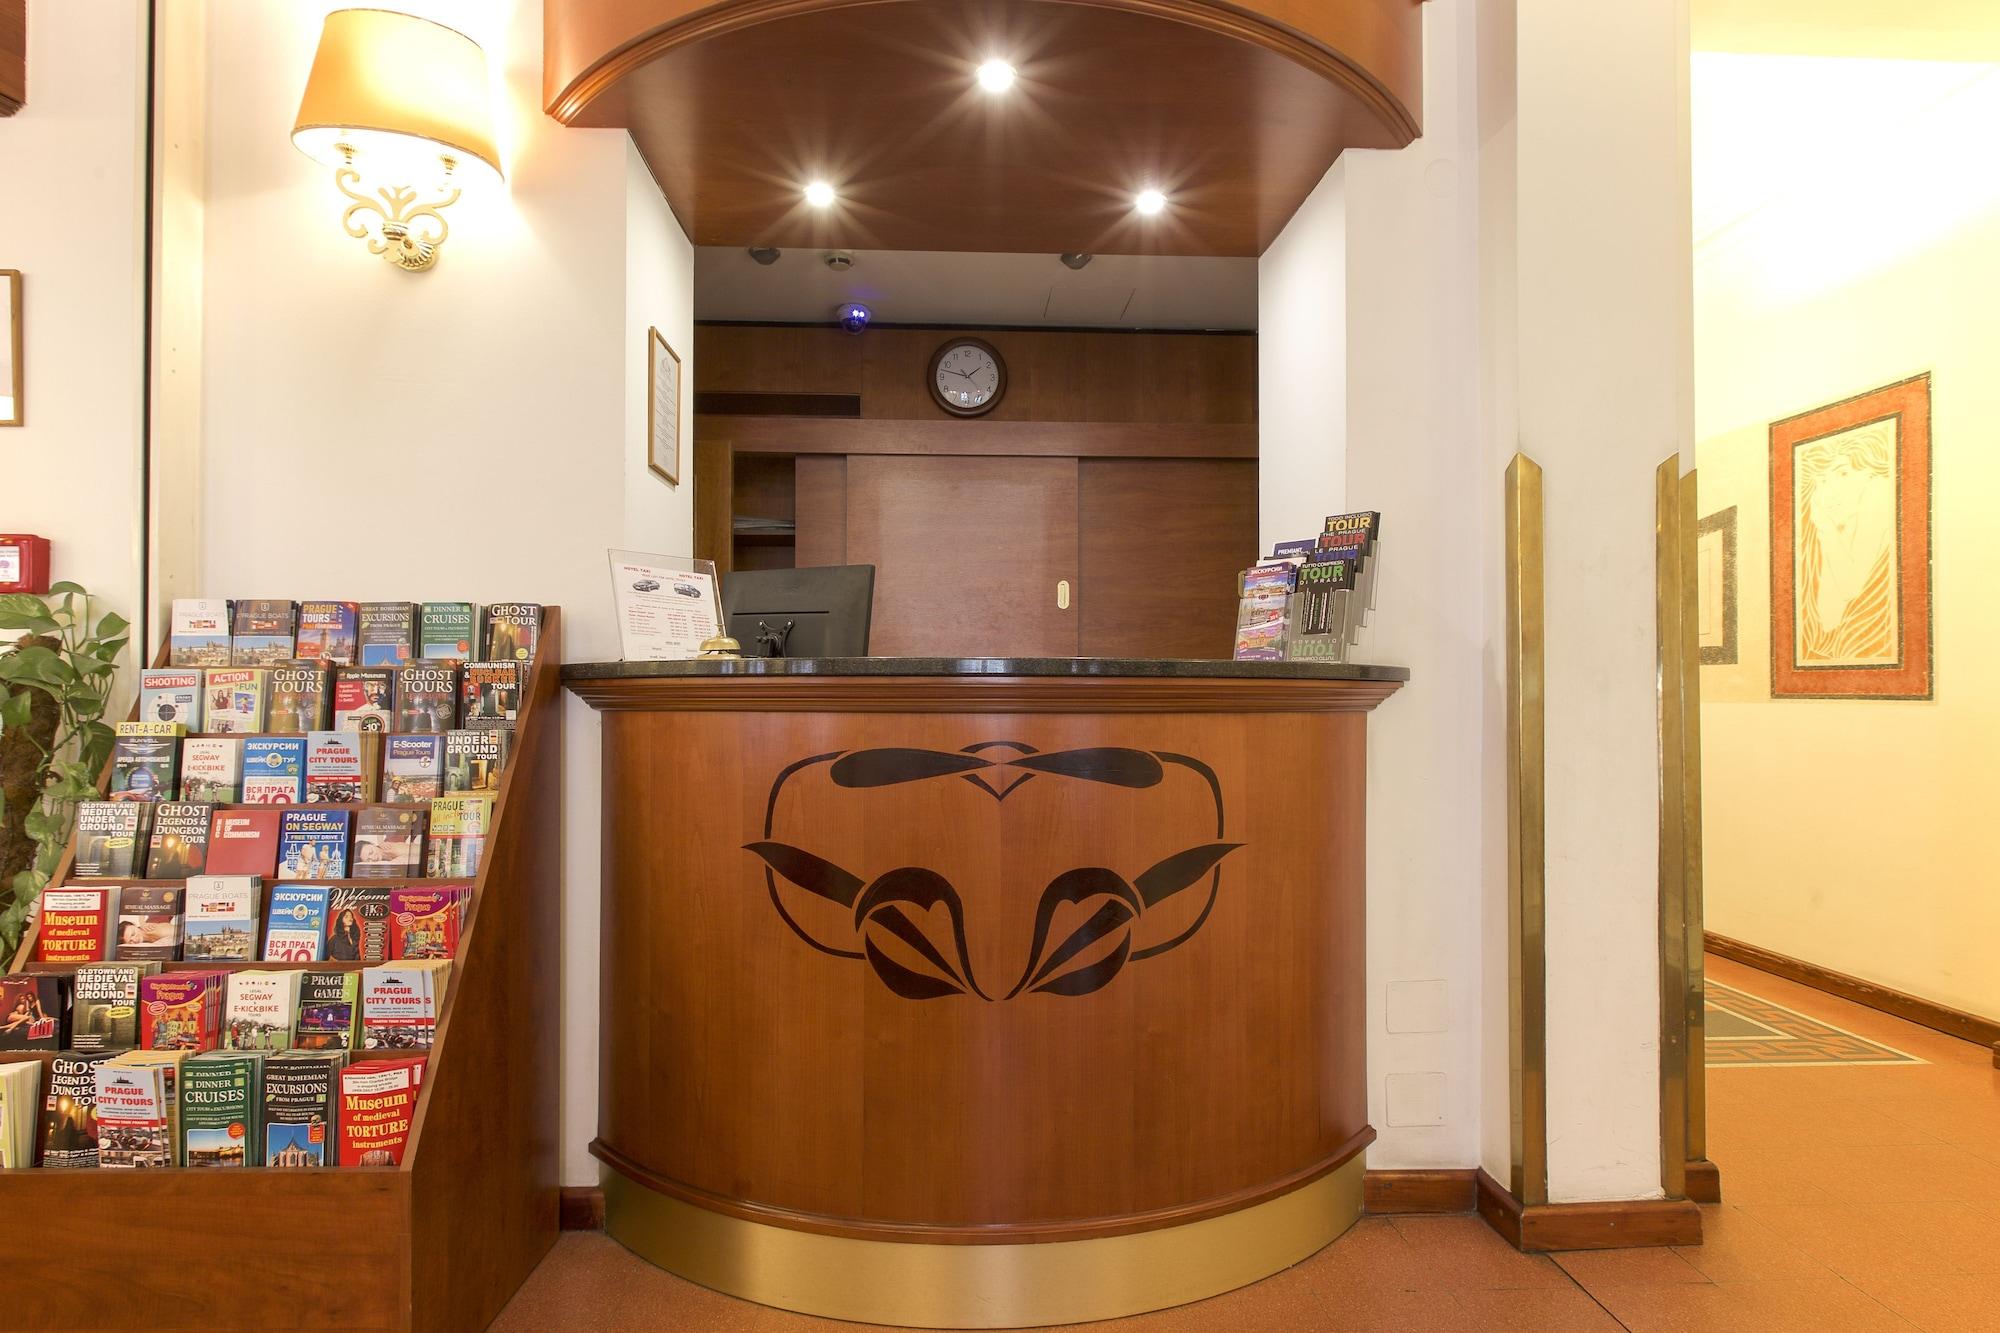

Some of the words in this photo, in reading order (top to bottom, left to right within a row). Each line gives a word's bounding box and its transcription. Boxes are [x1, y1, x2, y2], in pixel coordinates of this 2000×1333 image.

[1328, 518, 1370, 531] TOUR
[1322, 533, 1366, 548] TOUR
[1302, 566, 1344, 580] TOUR
[303, 604, 337, 614] PRAGUE
[492, 605, 536, 616] GHOST
[302, 614, 330, 622] TOURS
[362, 613, 410, 622] EXCURSIONS
[424, 614, 470, 624] CRUISES
[505, 616, 536, 626] TOUR
[214, 672, 249, 682] ACTION
[274, 669, 324, 680] GHOST
[404, 669, 453, 680] GHOST
[146, 677, 195, 686] SHOOTING
[272, 681, 324, 692] TOURS
[402, 681, 452, 692] TOURS
[120, 724, 172, 734] RENT-A-CAR
[448, 736, 489, 744] UNDER
[447, 745, 498, 754] GROUND
[157, 804, 209, 816] GHOST
[433, 801, 464, 810] PRAGUE
[157, 817, 198, 826] LEGENDS
[200, 816, 208, 826] &
[286, 814, 327, 822] PRAGUE
[458, 812, 481, 821] TOUR
[156, 826, 206, 835] DUNGEON
[286, 822, 300, 830] ON
[302, 822, 344, 830] SEGWAY
[180, 834, 206, 844] TOUR
[274, 893, 322, 902] ЭКСКУРСИИ
[330, 888, 390, 908] Welcome
[404, 902, 431, 912] Prague
[44, 912, 98, 926] Museum
[56, 928, 90, 936] medieval
[43, 939, 96, 950] TORTURE
[270, 940, 286, 948] ВСЯ
[289, 940, 316, 950] ПРАГА
[311, 976, 352, 986] PRAGUE
[76, 991, 125, 999] GROUND
[156, 991, 184, 1000] Prague
[314, 988, 350, 998] GAMES
[288, 1074, 328, 1082] BOHEMIAN
[196, 1080, 231, 1088] DINNER
[266, 1083, 328, 1094] EXCURSIONS
[104, 1086, 144, 1096] PRAGUE
[185, 1089, 244, 1102] CRUISES
[98, 1096, 118, 1104] CITY
[122, 1098, 154, 1106] TOURS
[346, 1094, 408, 1110] Museum
[353, 1113, 362, 1121] of
[362, 1109, 400, 1122] medieval
[346, 1120, 408, 1138] TORTURE
[352, 1137, 402, 1149] instruments
